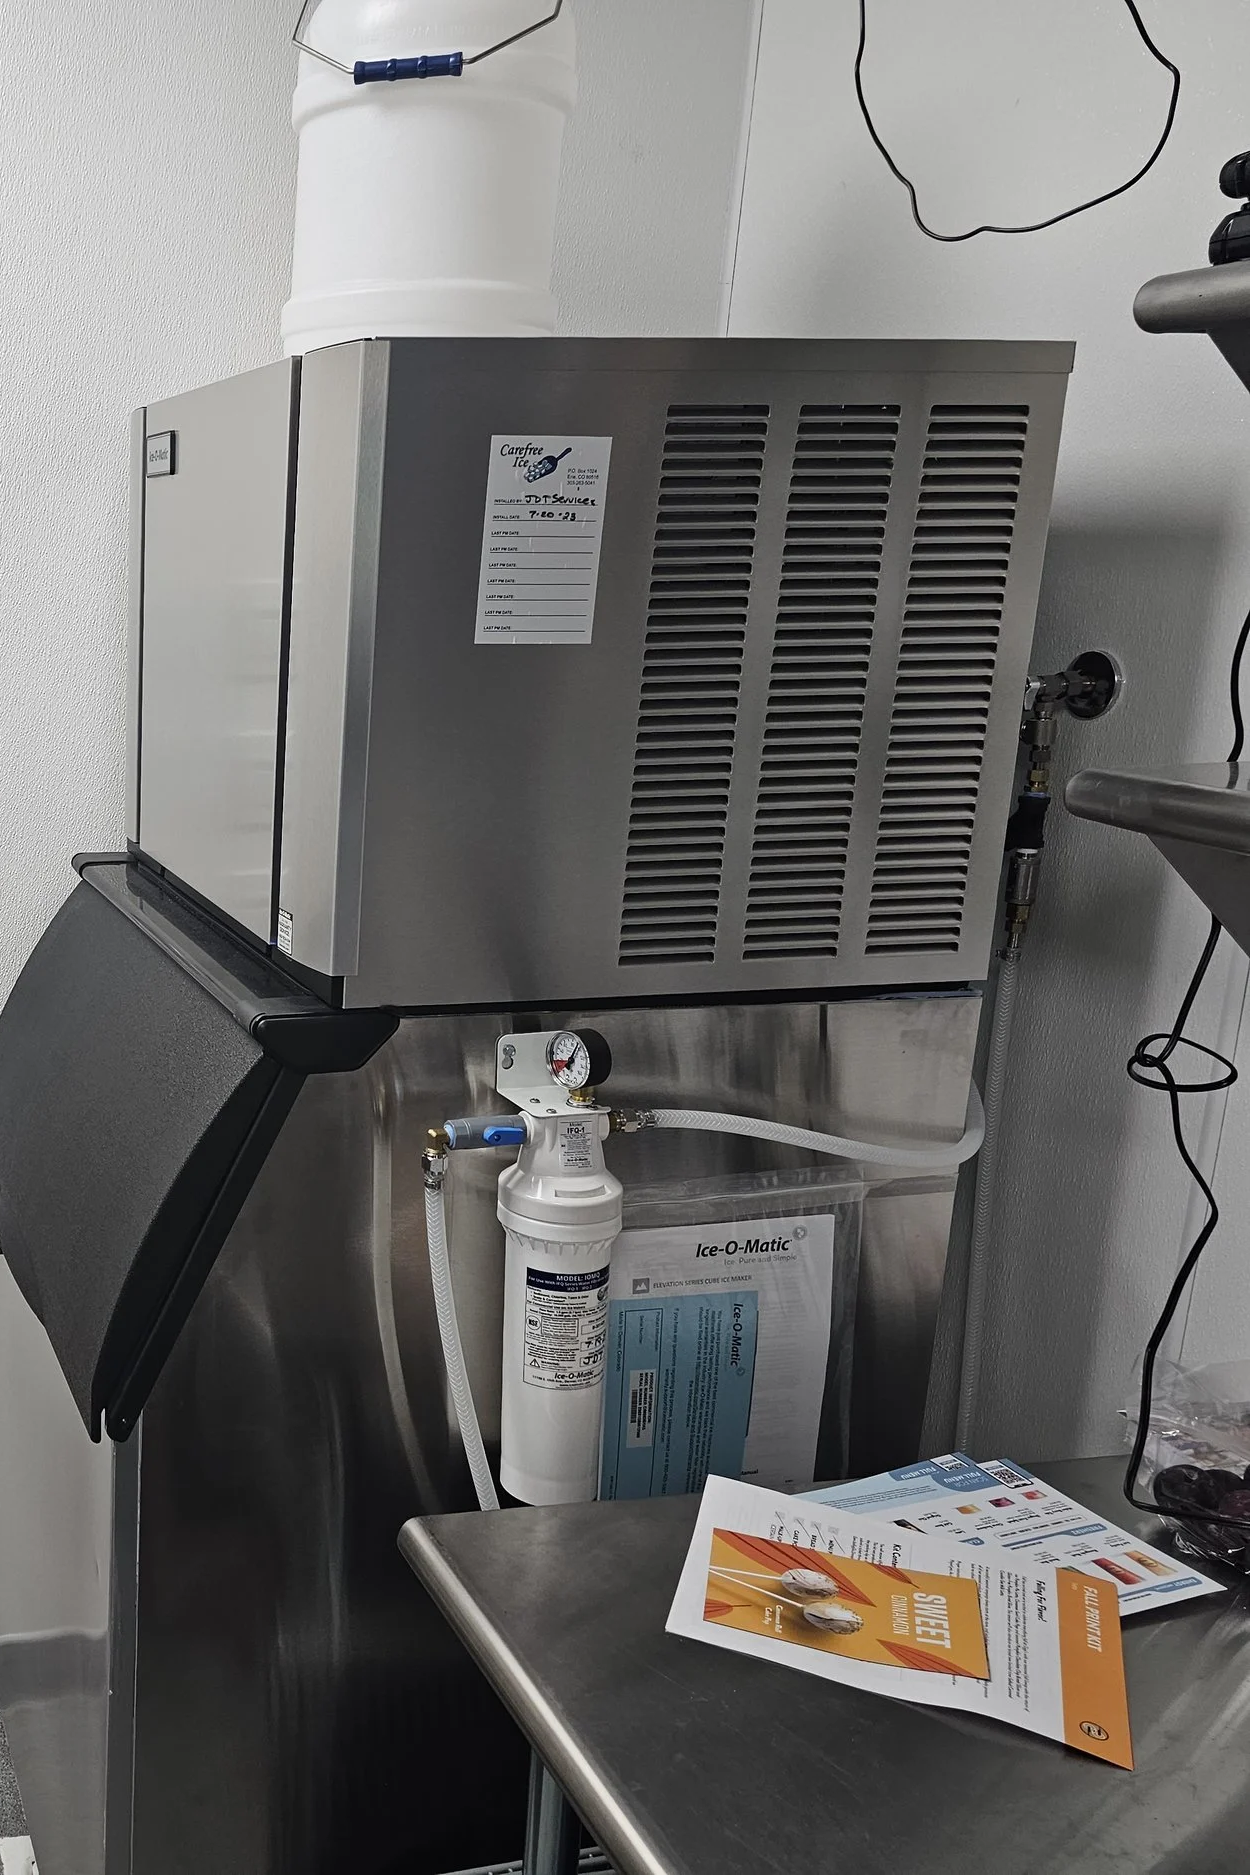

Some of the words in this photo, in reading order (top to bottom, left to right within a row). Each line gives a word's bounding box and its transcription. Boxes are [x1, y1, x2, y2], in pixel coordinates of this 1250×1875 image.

[500, 443, 544, 458] Carefree
[696, 1236, 790, 1258] Ice-O-Matic
[738, 1256, 756, 1264] Pure
[757, 1255, 772, 1263] and
[653, 1280, 684, 1288] ELEVATION
[730, 1303, 744, 1367] Ice-O-Matic
[554, 1370, 592, 1379] Ice-O-Matic
[900, 1471, 919, 1479] MENU
[920, 1466, 936, 1475] FULL
[963, 1471, 981, 1480] FULL
[944, 1475, 964, 1483] MENU
[1033, 1580, 1046, 1596] Falling
[1083, 1585, 1099, 1606] FALL
[1037, 1596, 1046, 1604] For
[890, 1594, 910, 1635] CINNAMON
[912, 1592, 952, 1649] SWEET
[1037, 1604, 1048, 1623] Flavor!
[1085, 1606, 1101, 1636] PRINT
[1086, 1635, 1102, 1653] KIT
